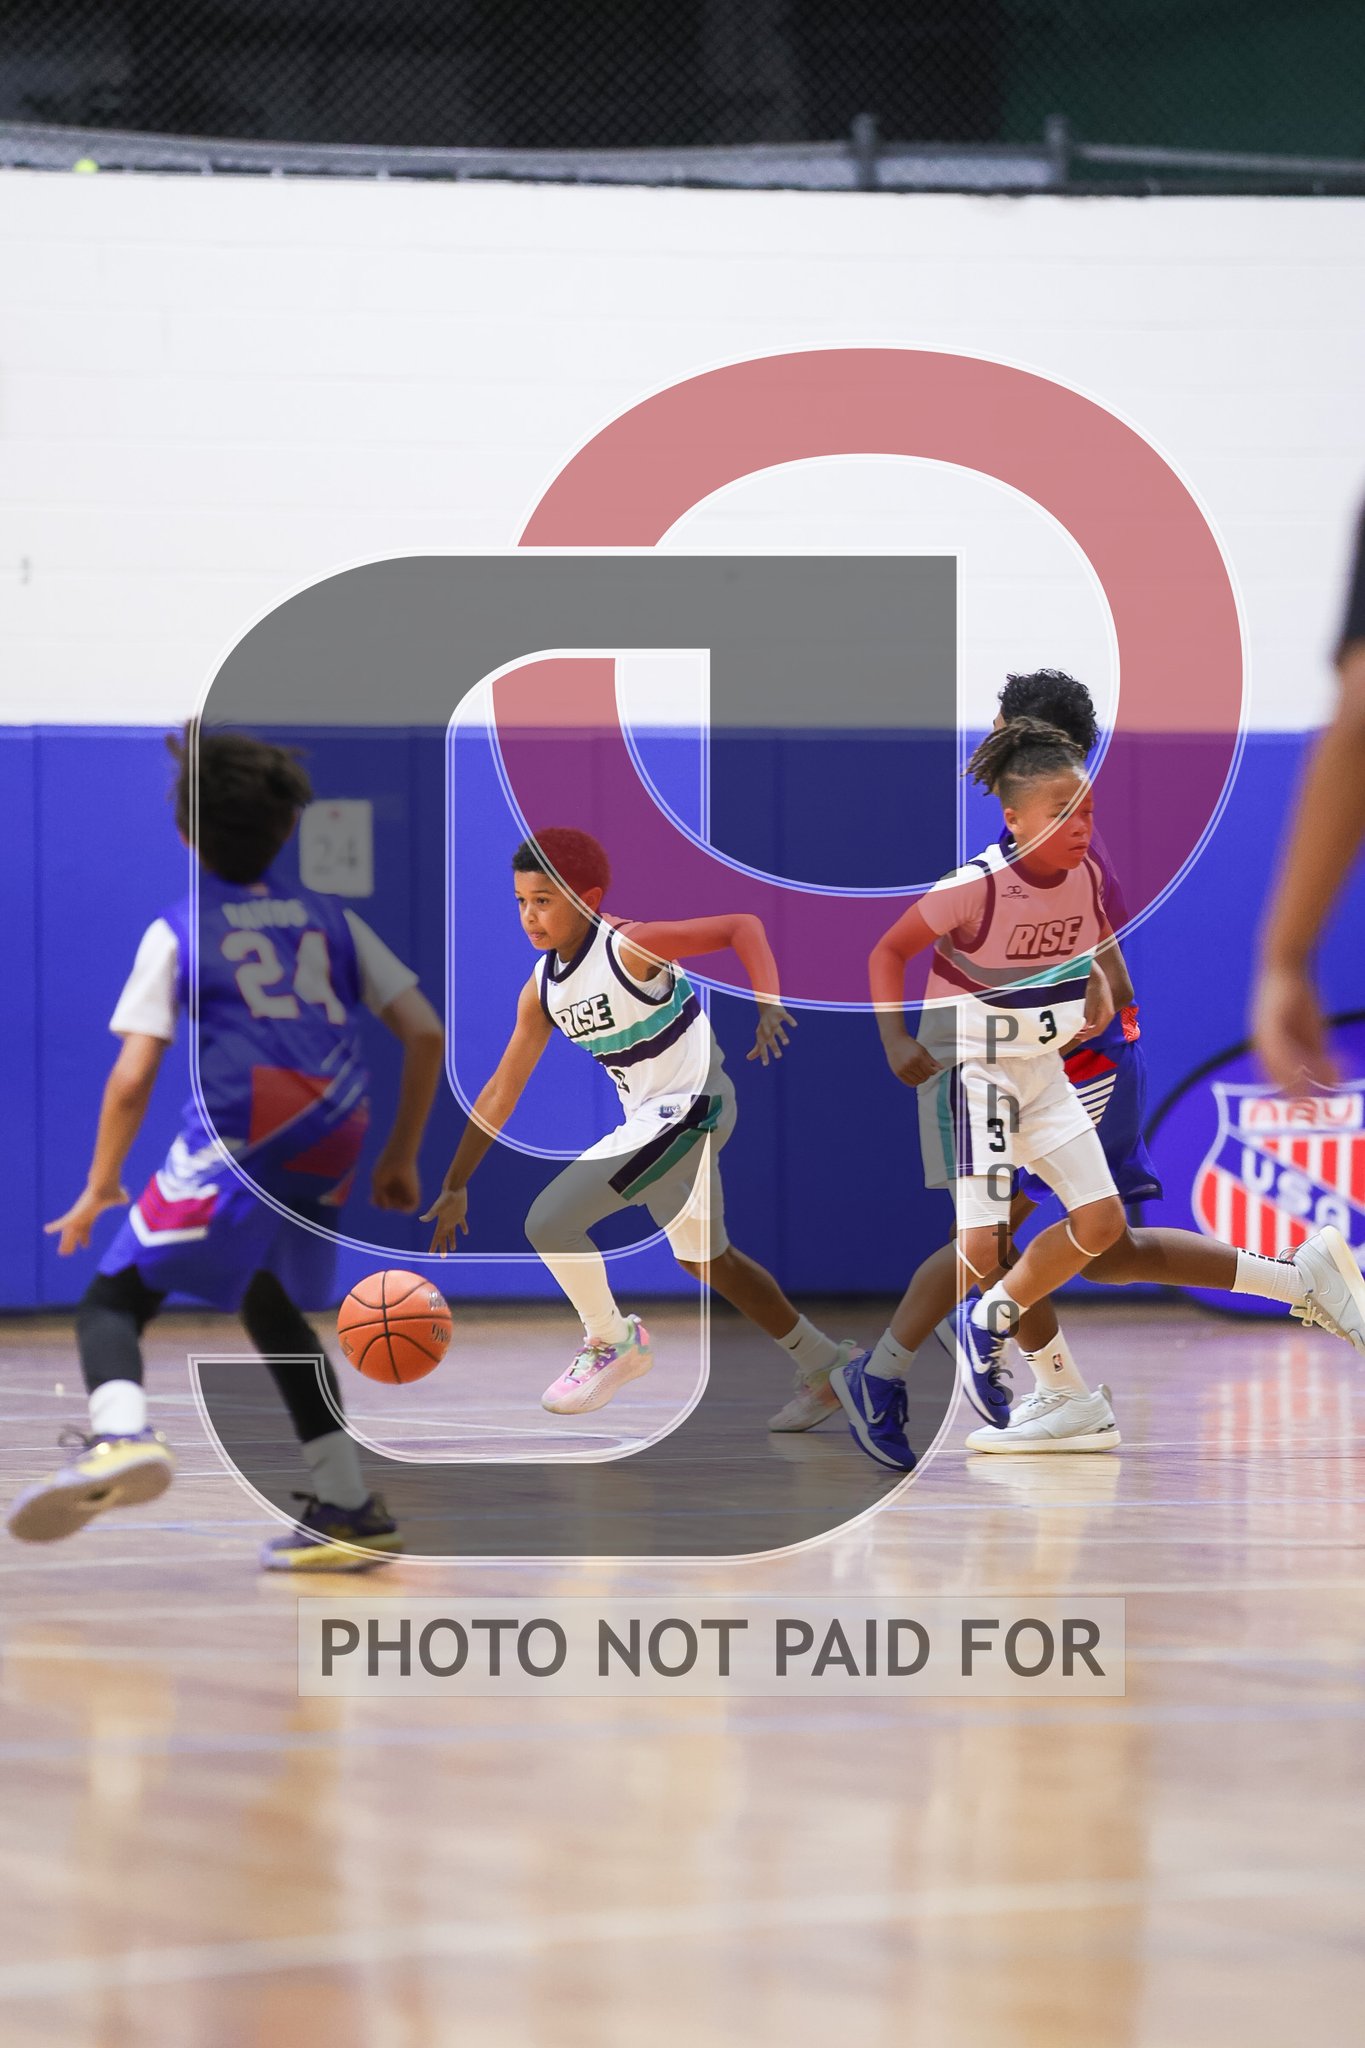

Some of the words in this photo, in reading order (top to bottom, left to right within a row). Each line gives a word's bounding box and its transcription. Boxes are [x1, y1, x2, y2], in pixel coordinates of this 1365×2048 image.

[1005, 916, 1083, 960] RISE
[220, 930, 347, 1025] 24
[556, 993, 615, 1038] RISE
[1038, 1009, 1058, 1045] 3
[987, 1118, 1007, 1153] 3
[1241, 1146, 1351, 1243] USA
